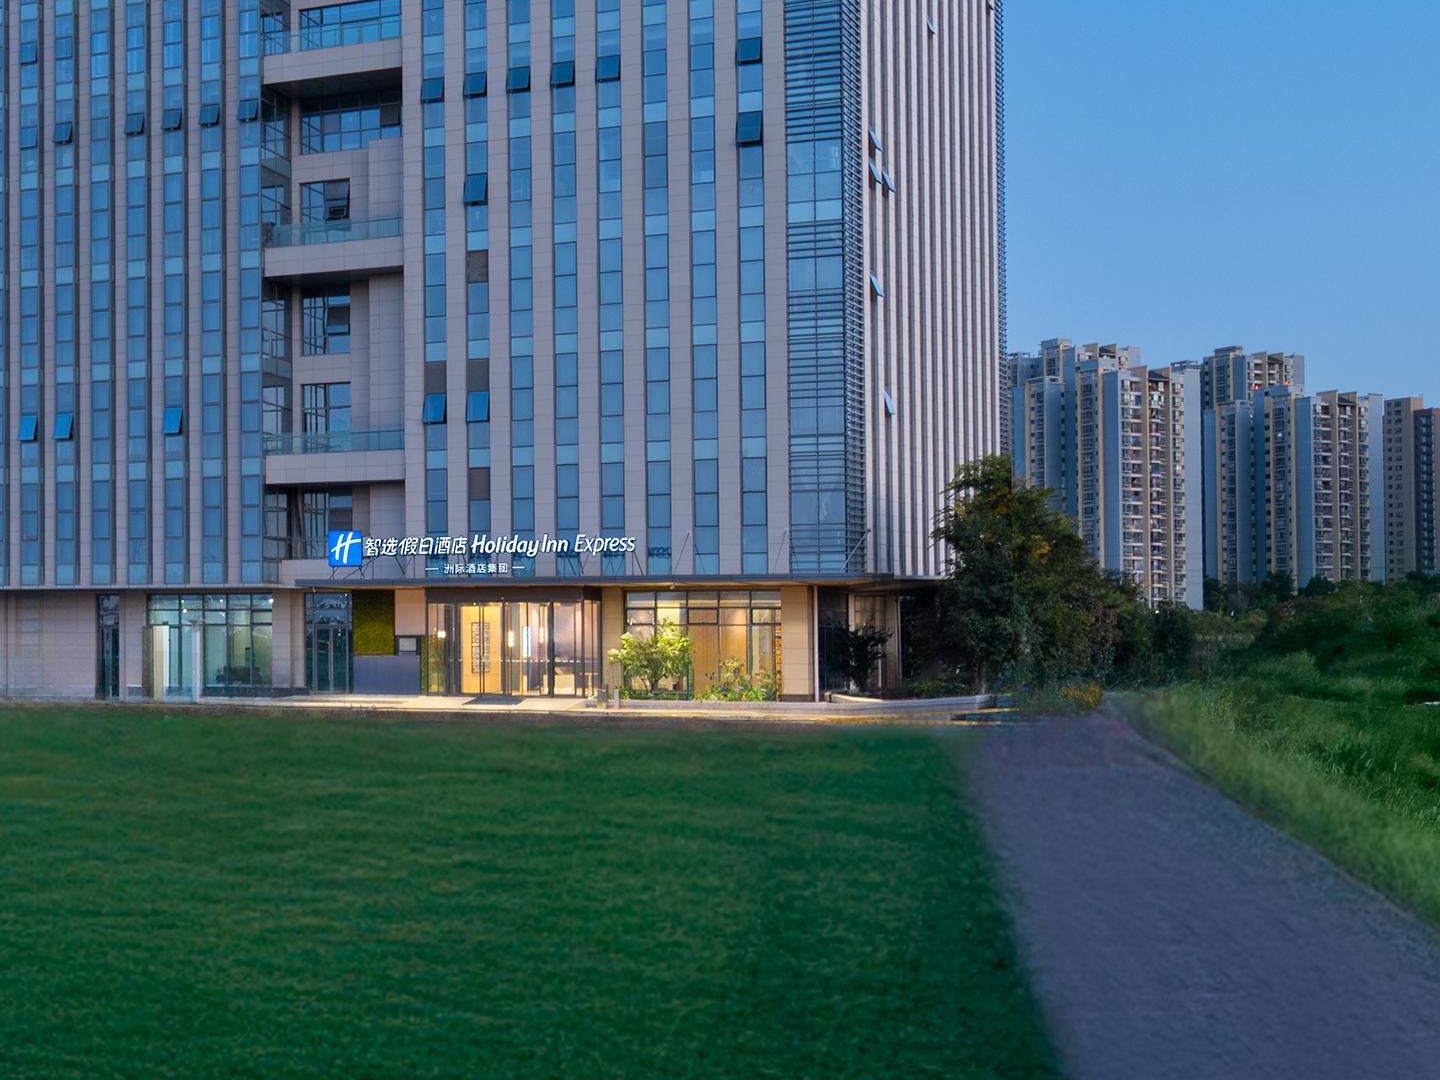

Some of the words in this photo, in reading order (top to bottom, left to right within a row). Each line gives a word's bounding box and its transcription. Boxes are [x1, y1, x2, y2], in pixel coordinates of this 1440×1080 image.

[364, 536, 468, 557] 智选假日酒店
[471, 534, 540, 557] Holiday
[541, 533, 568, 553] Inn
[574, 534, 636, 556] Express
[443, 562, 508, 575] 洲际酒店集团
